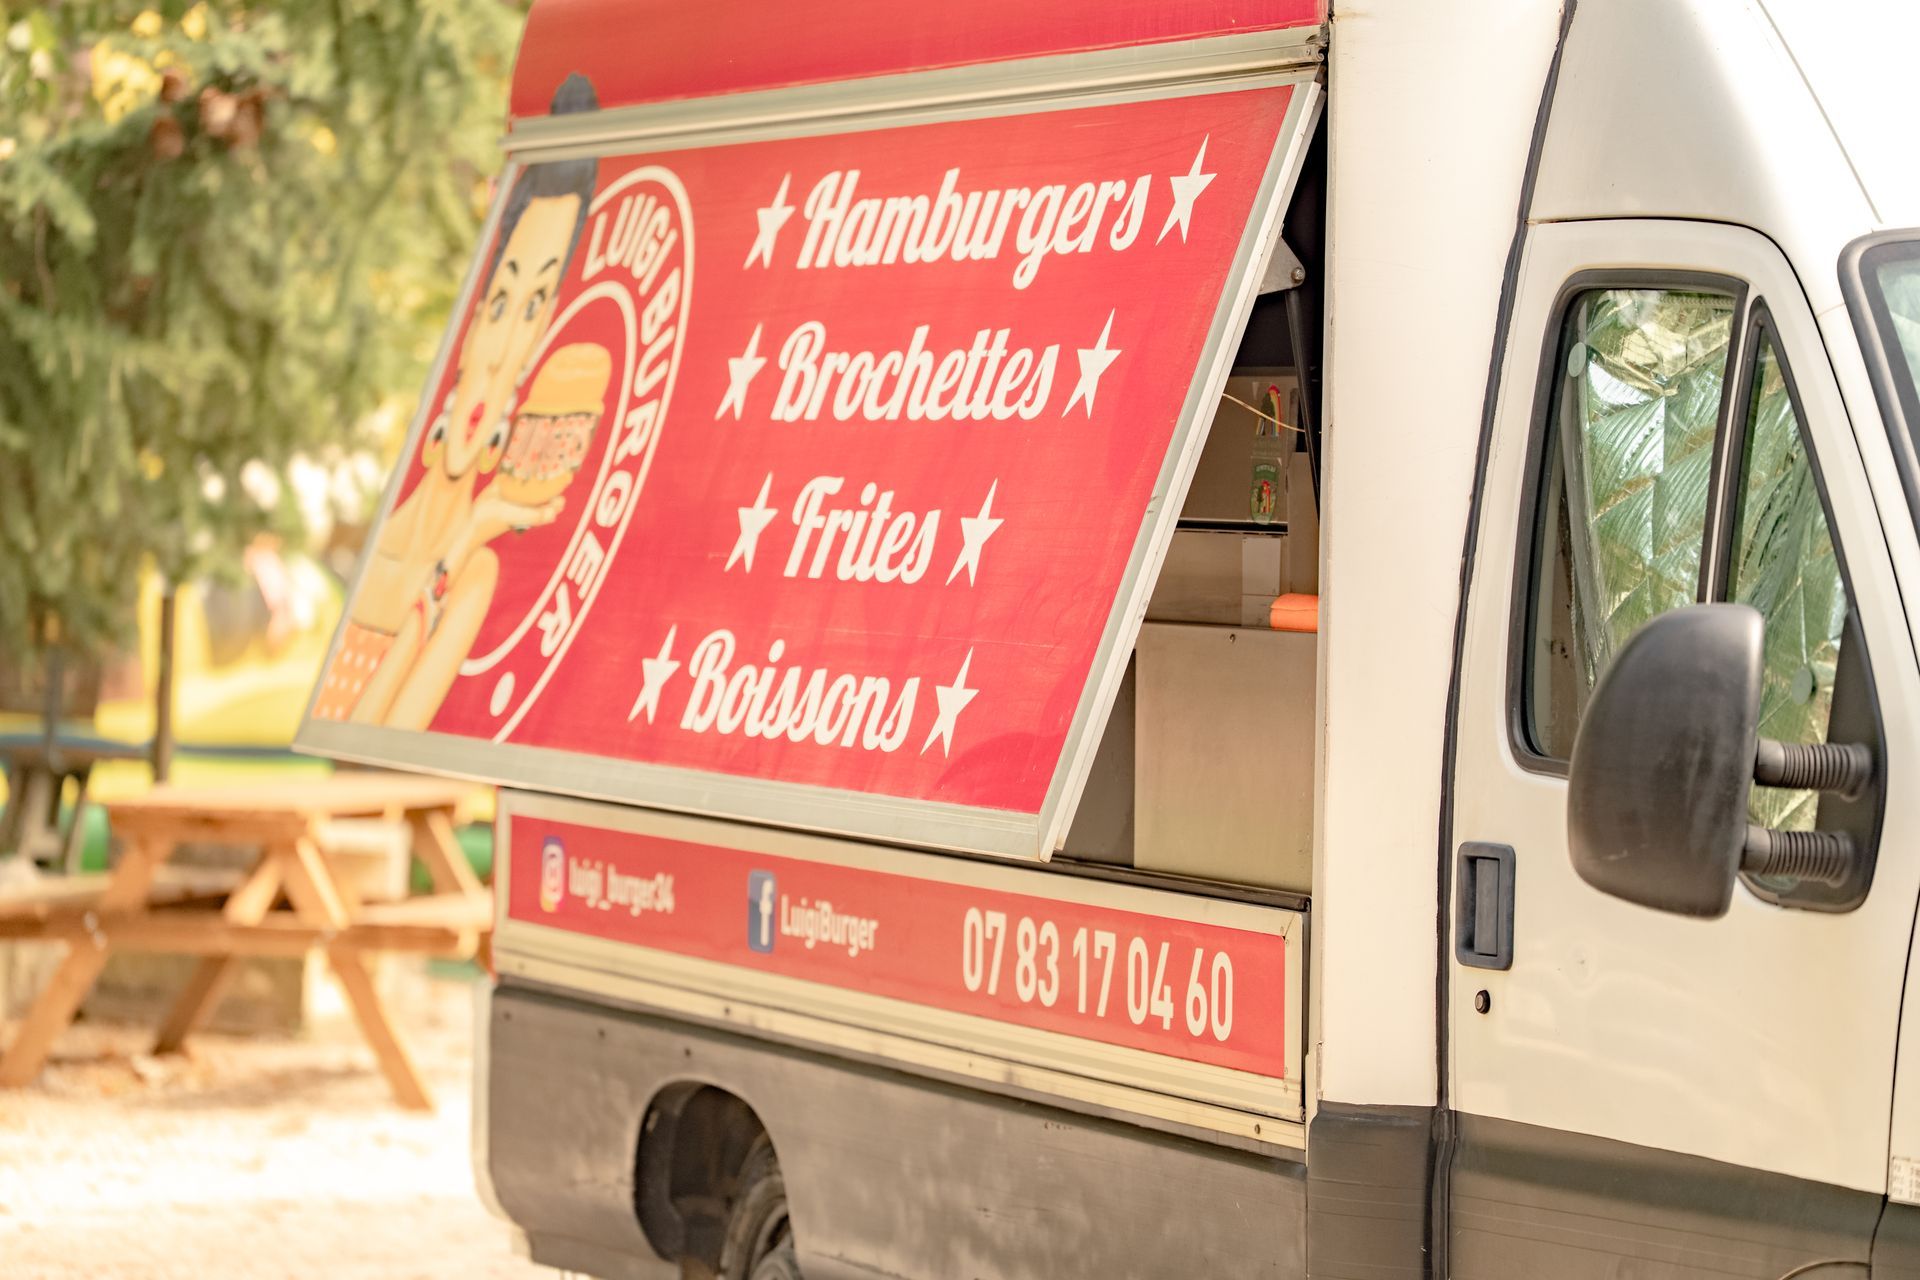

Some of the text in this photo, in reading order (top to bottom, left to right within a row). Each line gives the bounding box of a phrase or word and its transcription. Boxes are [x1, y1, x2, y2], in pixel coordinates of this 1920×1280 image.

[796, 168, 1153, 290] Hamburgers
[535, 194, 682, 659] LUIGI BURGER
[770, 320, 1061, 423] Brochettes
[783, 475, 942, 585] Frites
[680, 628, 921, 753] Boissons
[780, 893, 880, 958] LuigiBurger
[962, 906, 1234, 1042] 07 83 17 04 60
